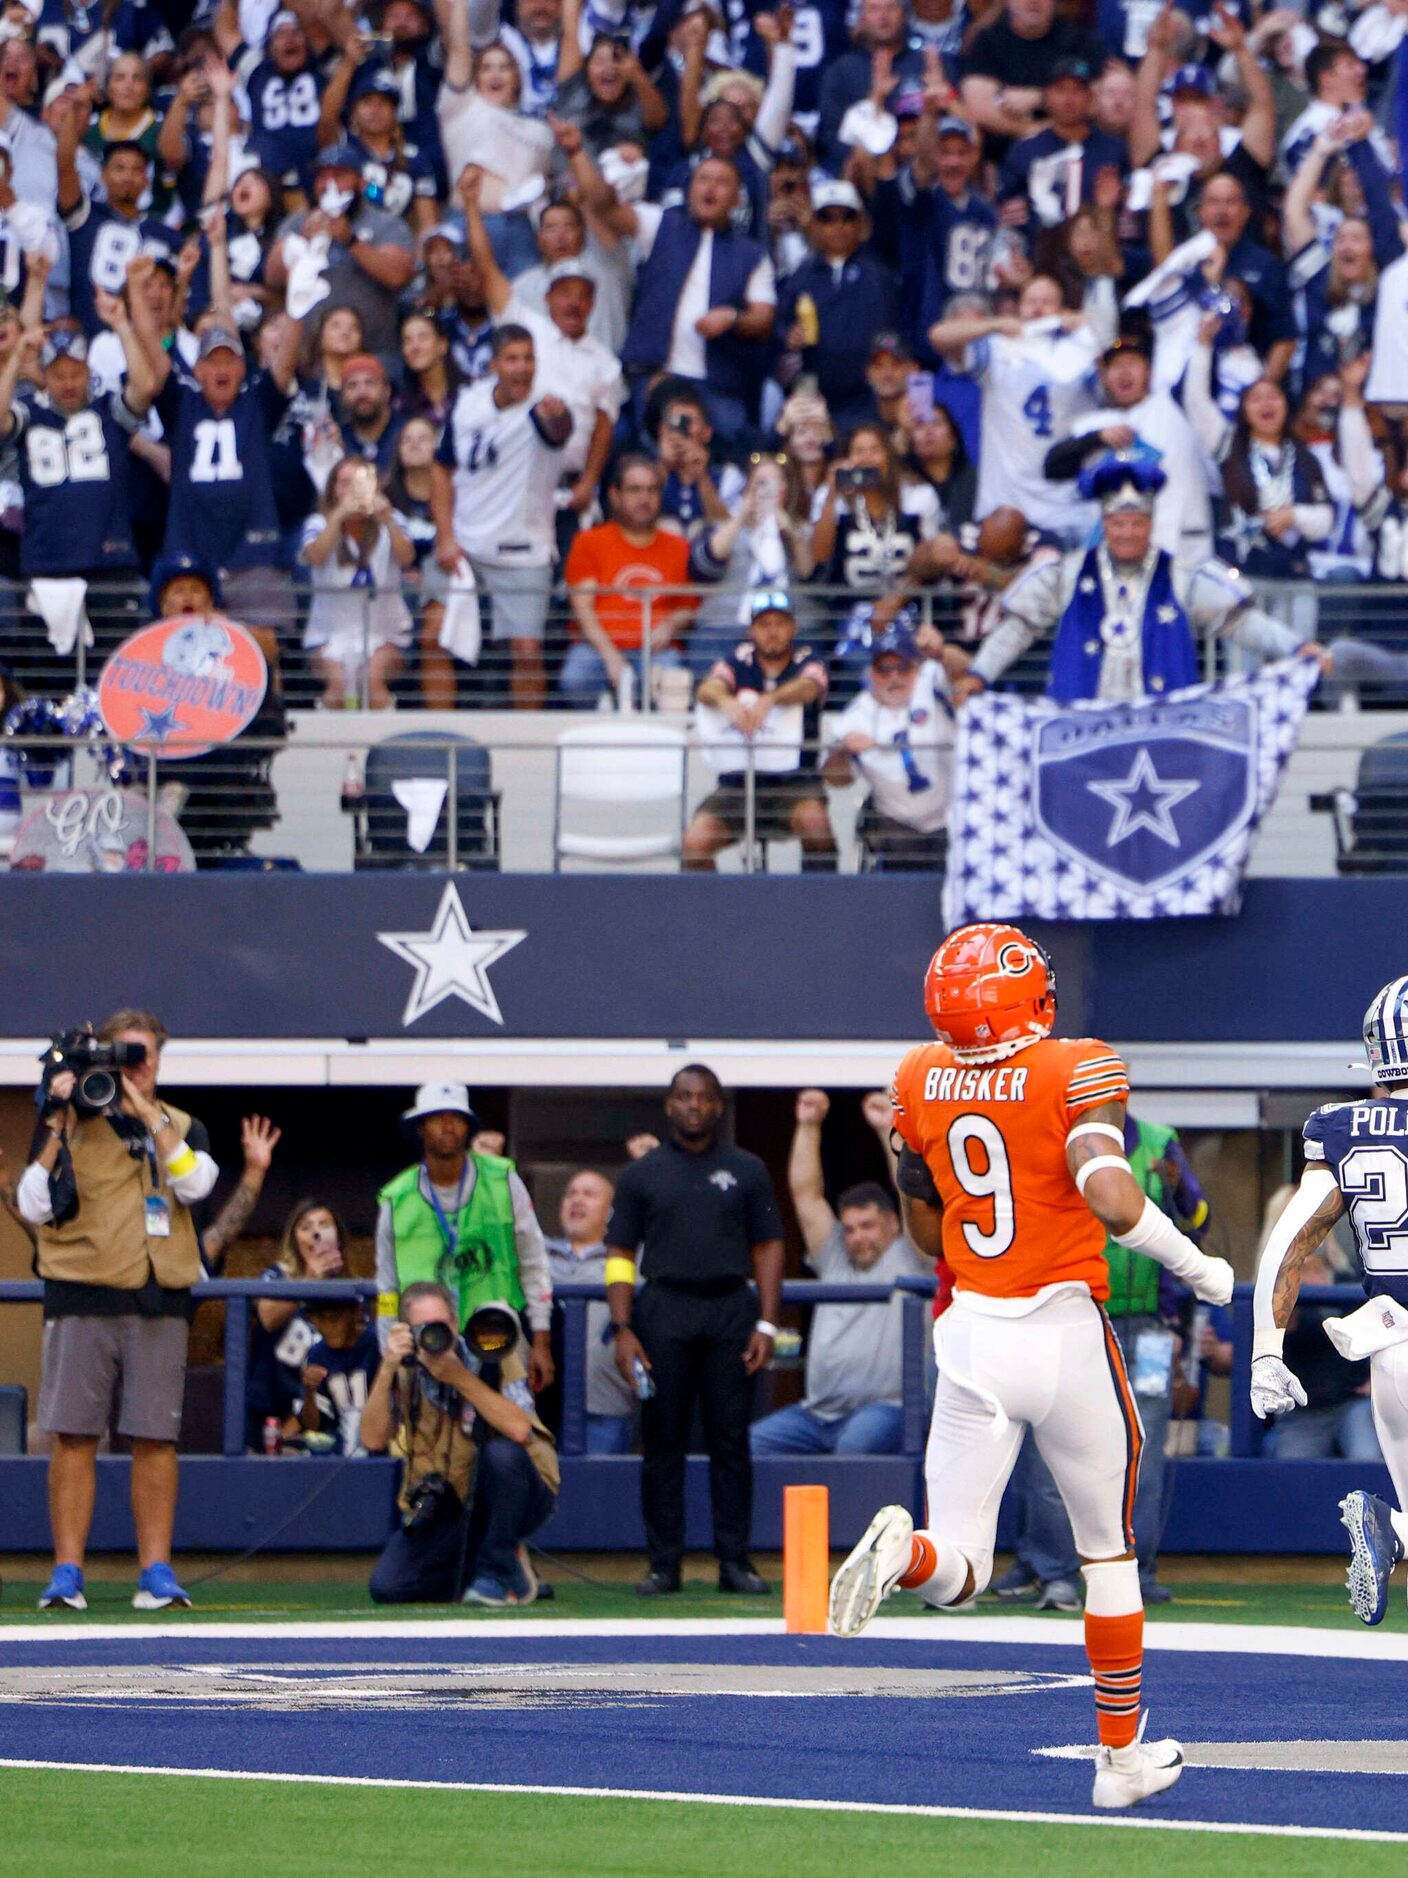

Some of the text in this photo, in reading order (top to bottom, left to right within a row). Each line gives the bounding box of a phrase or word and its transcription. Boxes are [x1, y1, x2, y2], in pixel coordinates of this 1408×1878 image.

[1023, 384, 1053, 437] 4
[189, 418, 244, 483] 11
[923, 1066, 1030, 1102] BRISKER
[946, 1112, 1014, 1259] 9
